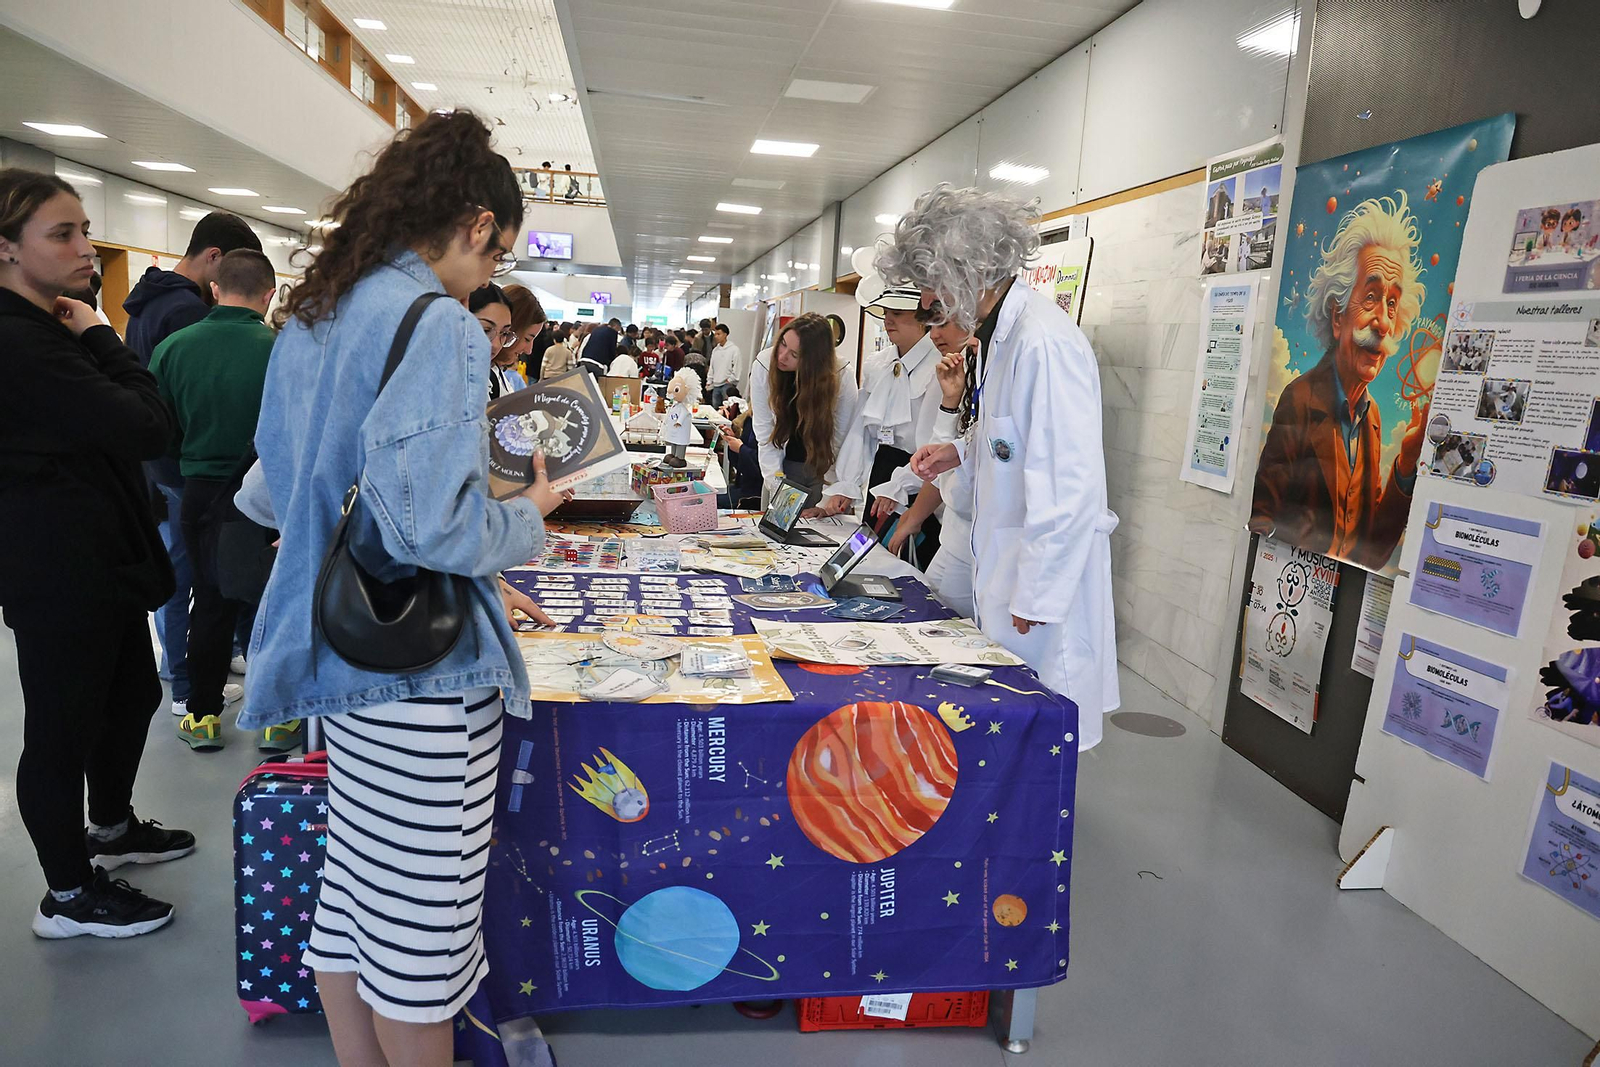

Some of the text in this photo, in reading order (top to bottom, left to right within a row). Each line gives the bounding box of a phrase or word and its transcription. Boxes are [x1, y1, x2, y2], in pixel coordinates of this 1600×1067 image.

[1516, 304, 1582, 315] Nuestros talleres
[534, 393, 560, 404] Miguel
[501, 467, 525, 477] MOLINA
[1455, 530, 1500, 547] BIOMOLÉCULAS
[1263, 552, 1274, 561] 2025
[1256, 587, 1264, 596] 30
[1426, 665, 1468, 687] BIOMOLÉCULAS
[709, 717, 725, 782] MERCURY
[880, 868, 895, 917] JUPITER
[582, 919, 601, 966] URANUS
